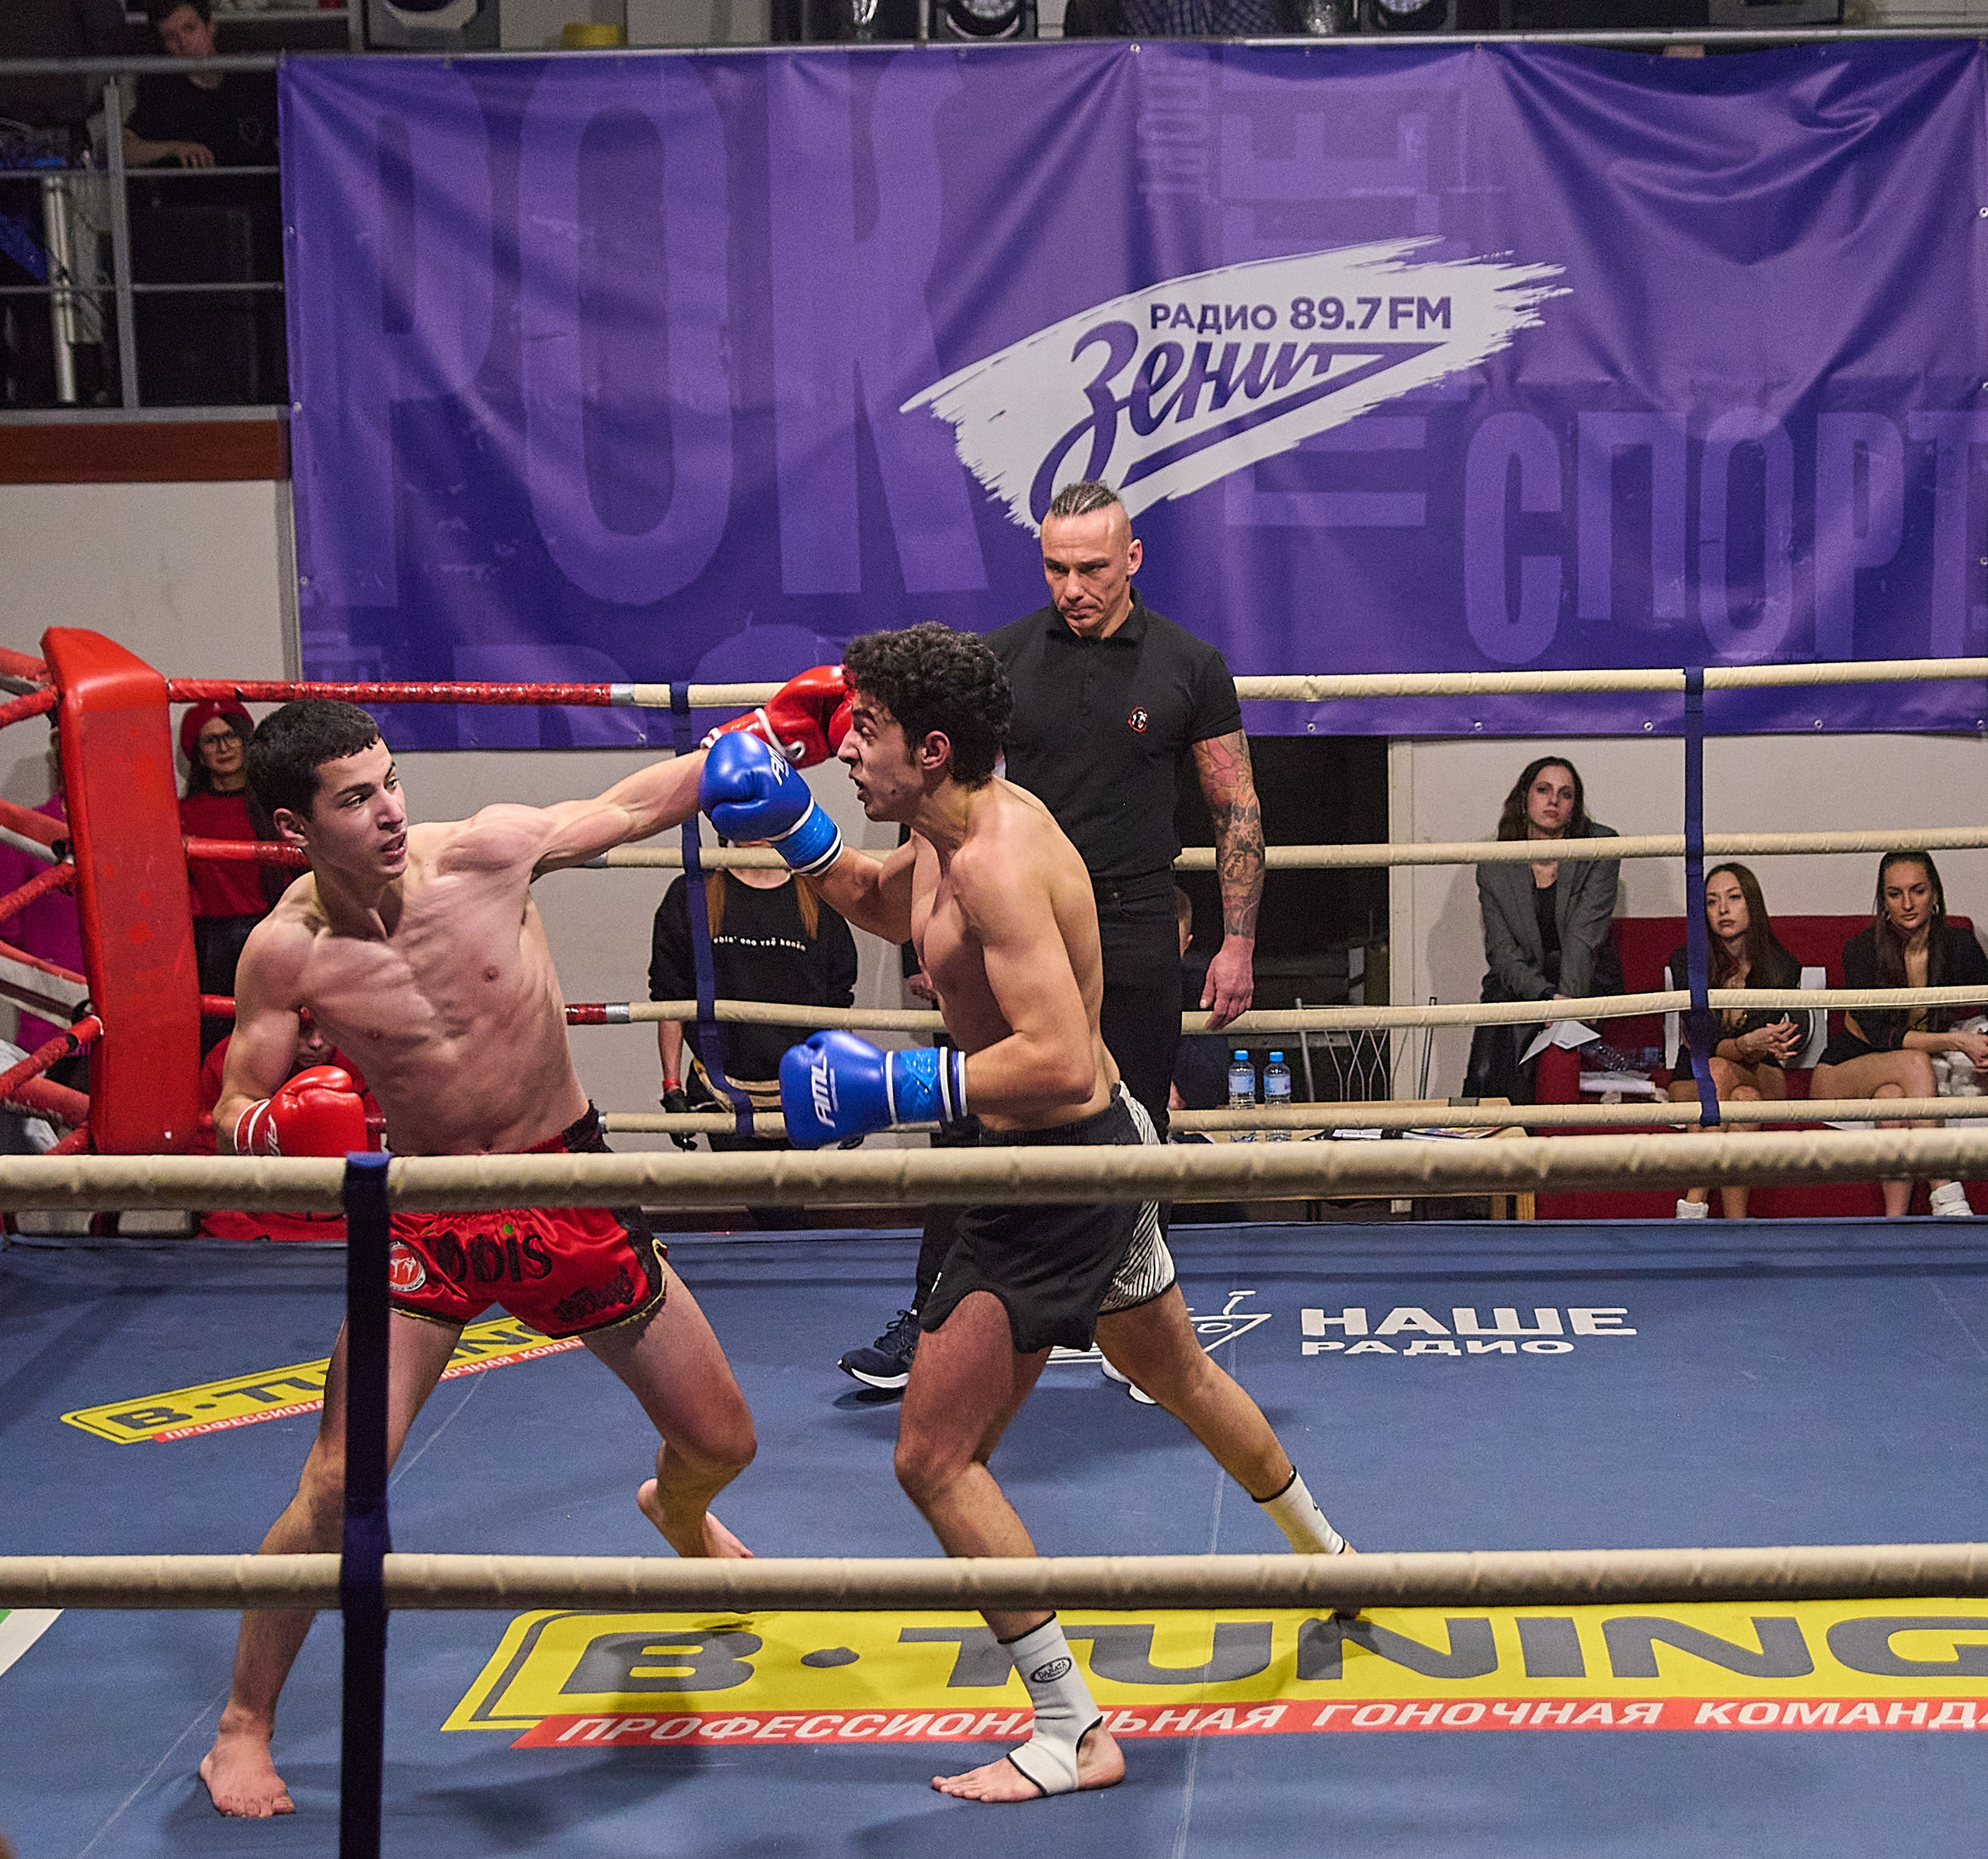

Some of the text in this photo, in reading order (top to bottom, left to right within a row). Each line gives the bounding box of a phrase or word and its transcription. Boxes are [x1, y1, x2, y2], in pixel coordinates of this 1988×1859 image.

[1150, 303, 1277, 335] РАДИО
[1465, 406, 1988, 664] СПОРТ
[1302, 1307, 1637, 1336] НАШЕ
[1302, 1340, 1576, 1357] РАДИО
[556, 1701, 1988, 1742] ПРОФЕССИОНЬНАЯ ГОНОЧНАЯ КОМАНД
